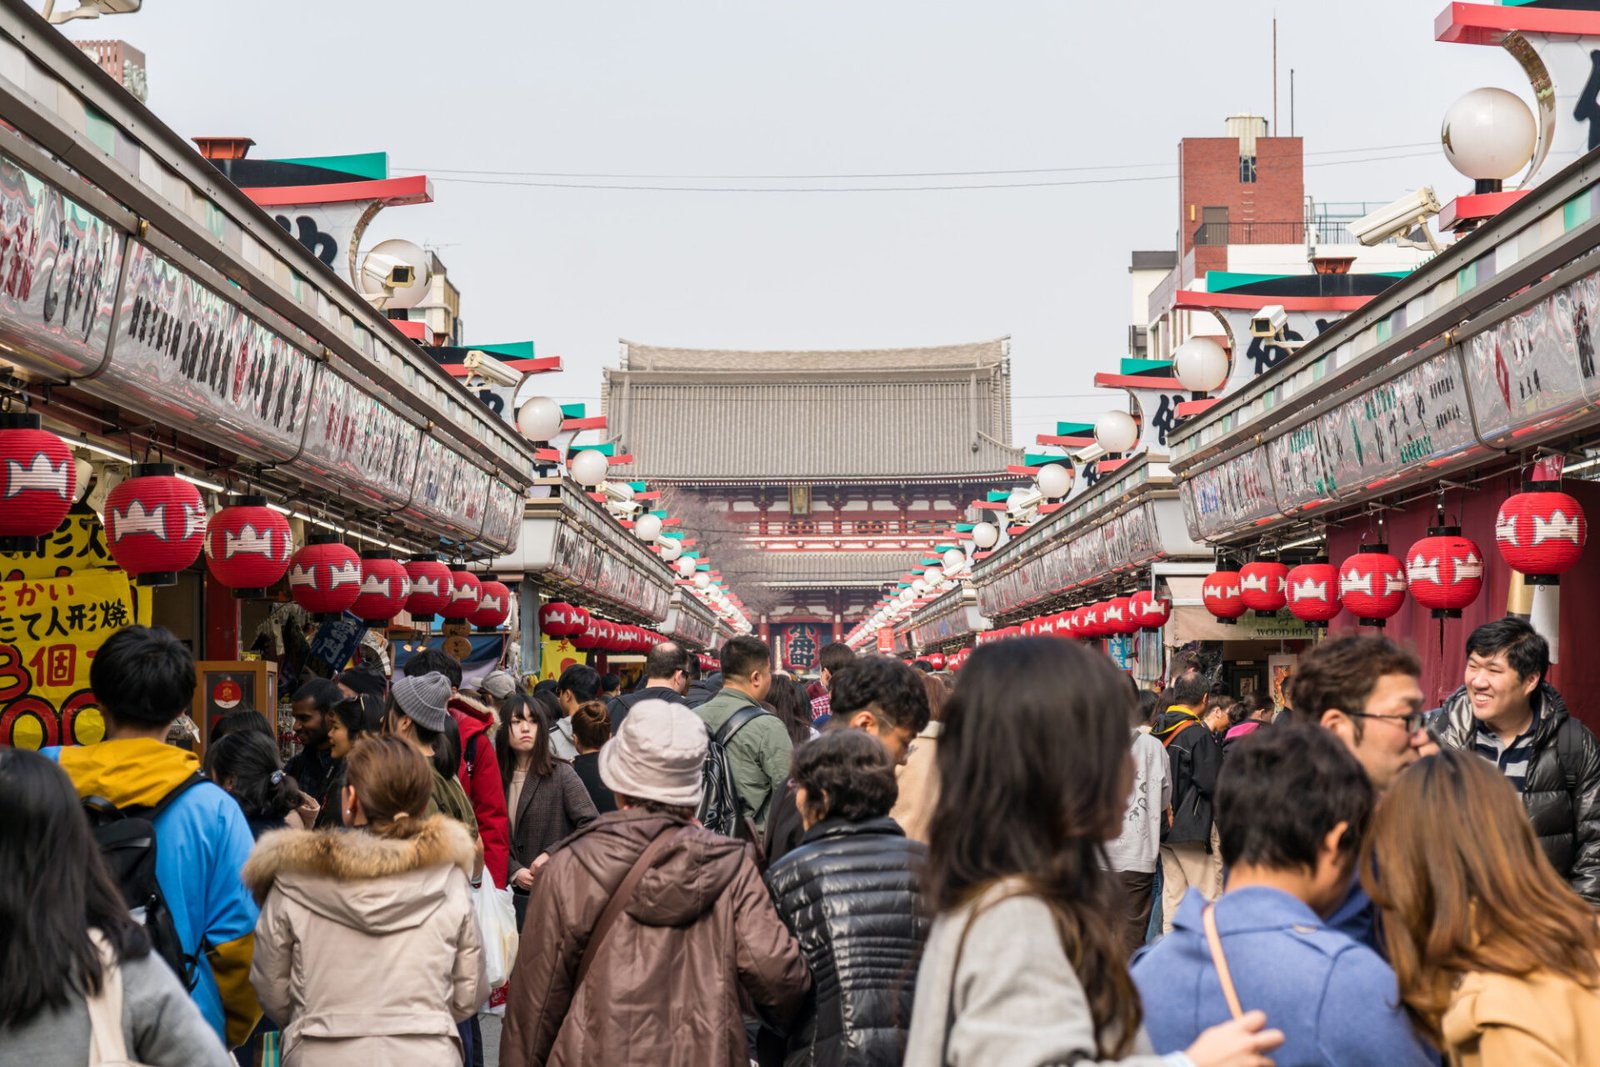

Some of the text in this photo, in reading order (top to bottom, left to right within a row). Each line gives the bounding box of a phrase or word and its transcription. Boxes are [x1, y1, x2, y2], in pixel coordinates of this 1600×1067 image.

[0, 582, 75, 611] かい
[789, 624, 816, 667] 小舟町
[1256, 628, 1290, 636] WOOD
